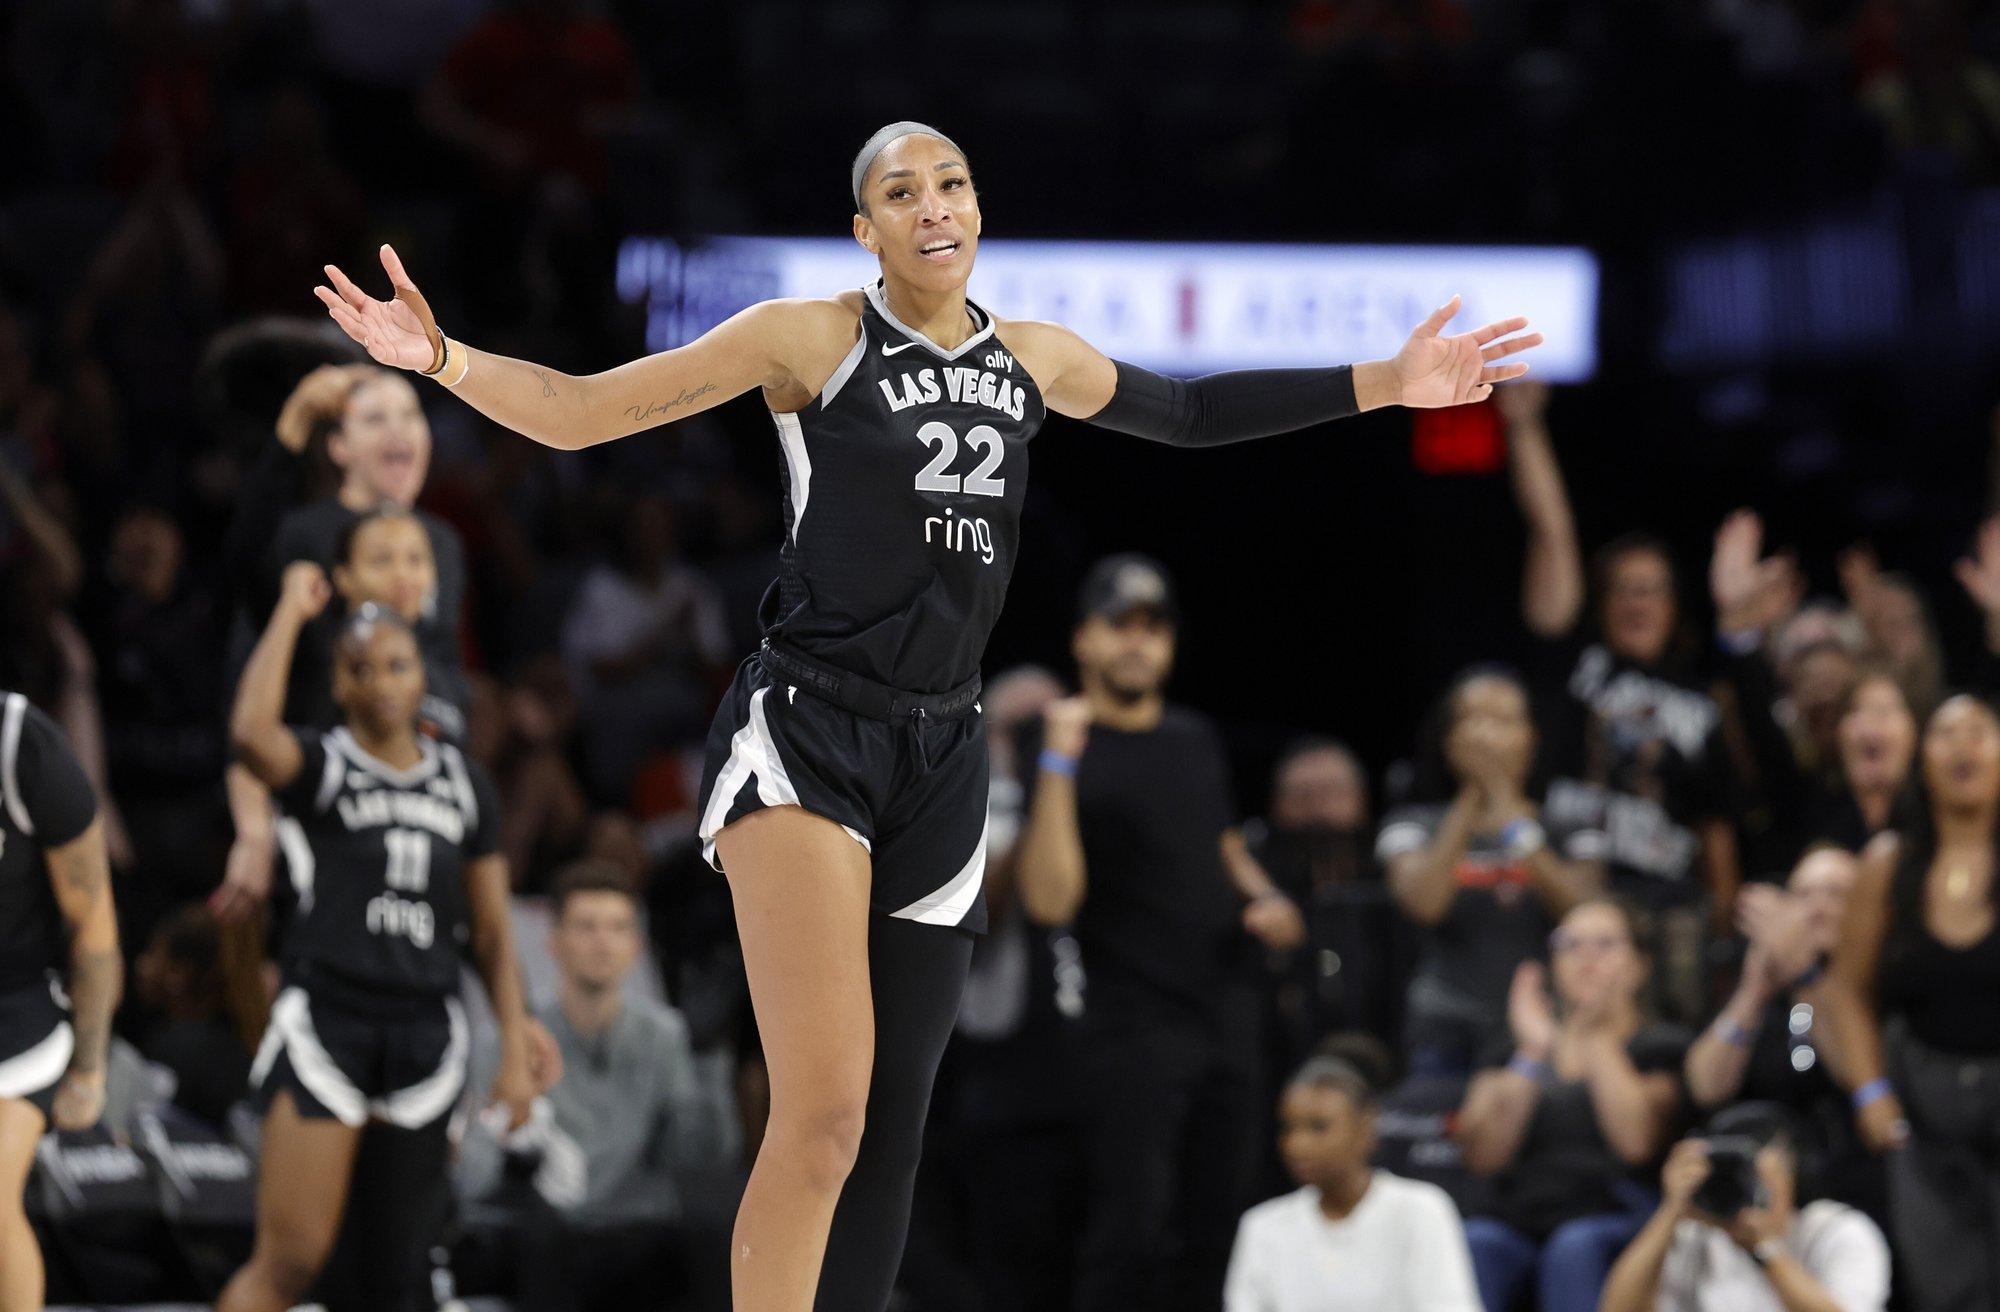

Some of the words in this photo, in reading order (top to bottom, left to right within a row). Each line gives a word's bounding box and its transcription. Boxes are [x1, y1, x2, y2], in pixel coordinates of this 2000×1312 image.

[985, 350, 1013, 373] ally
[877, 368, 941, 412] LAS
[943, 367, 1026, 421] VEGAS
[915, 421, 1005, 497] 22
[925, 507, 994, 564] ring
[384, 827, 432, 893] 11
